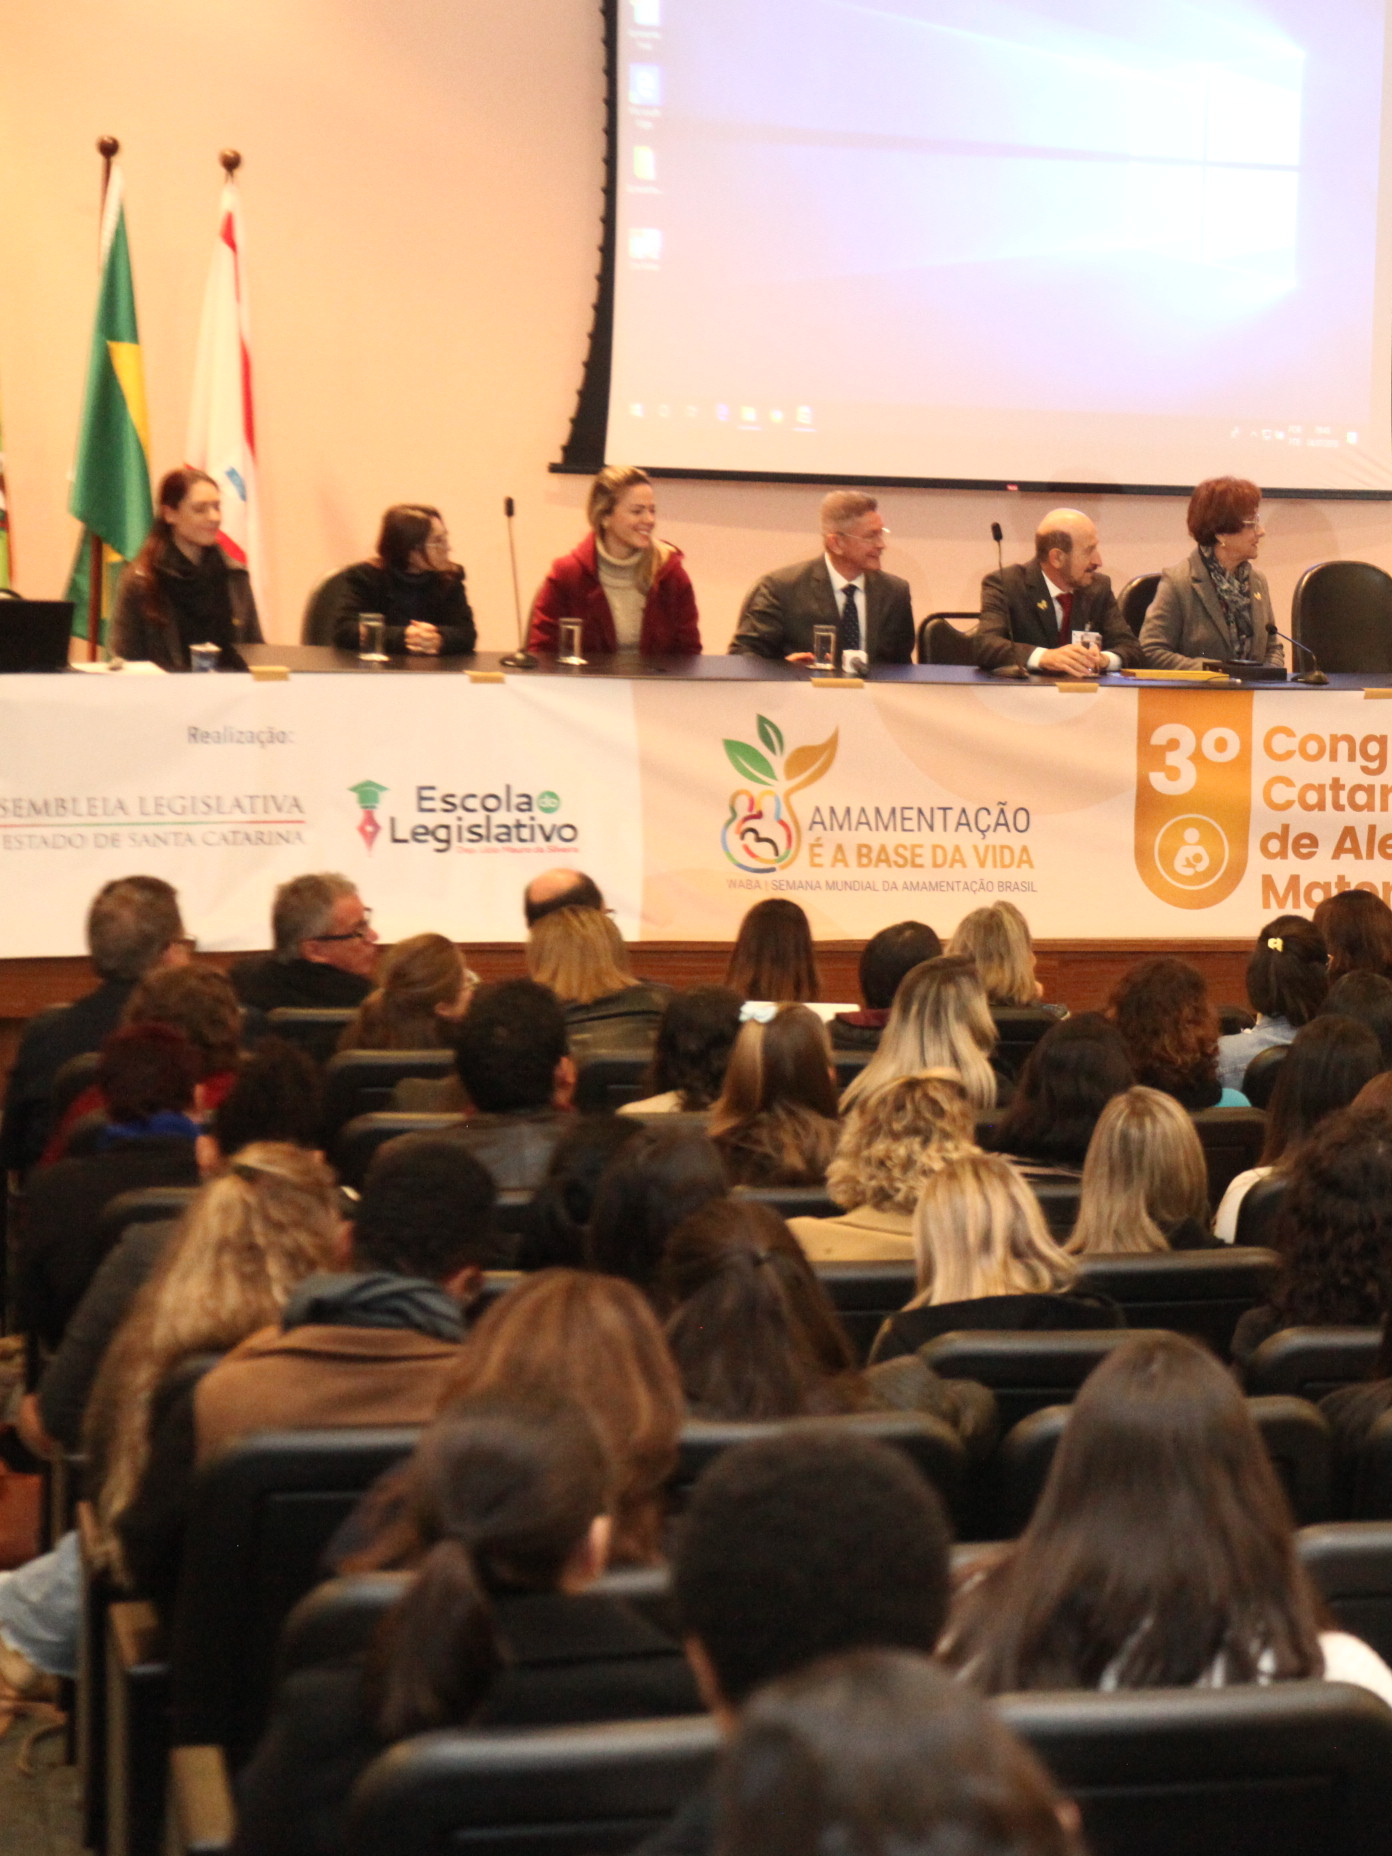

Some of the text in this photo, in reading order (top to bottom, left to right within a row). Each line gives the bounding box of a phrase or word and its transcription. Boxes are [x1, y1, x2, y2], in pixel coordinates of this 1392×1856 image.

[186, 725, 295, 749] Realização:
[138, 795, 305, 816] LEGISLATIVA
[416, 784, 533, 813] Escola
[389, 814, 579, 853] Legislativo
[808, 801, 1031, 840] AMAMENTAÇÃO
[2, 830, 306, 850] ESTADO DE SANTA CATARINA
[808, 837, 1035, 869] É A BASE DA VIDA
[1259, 824, 1319, 861] de
[771, 879, 821, 891] SEMANA
[825, 879, 879, 892] MUNDIAL
[882, 879, 899, 892] DA
[901, 877, 994, 895] AMAMENTAÇÃO
[998, 880, 1037, 893] BRASIL
